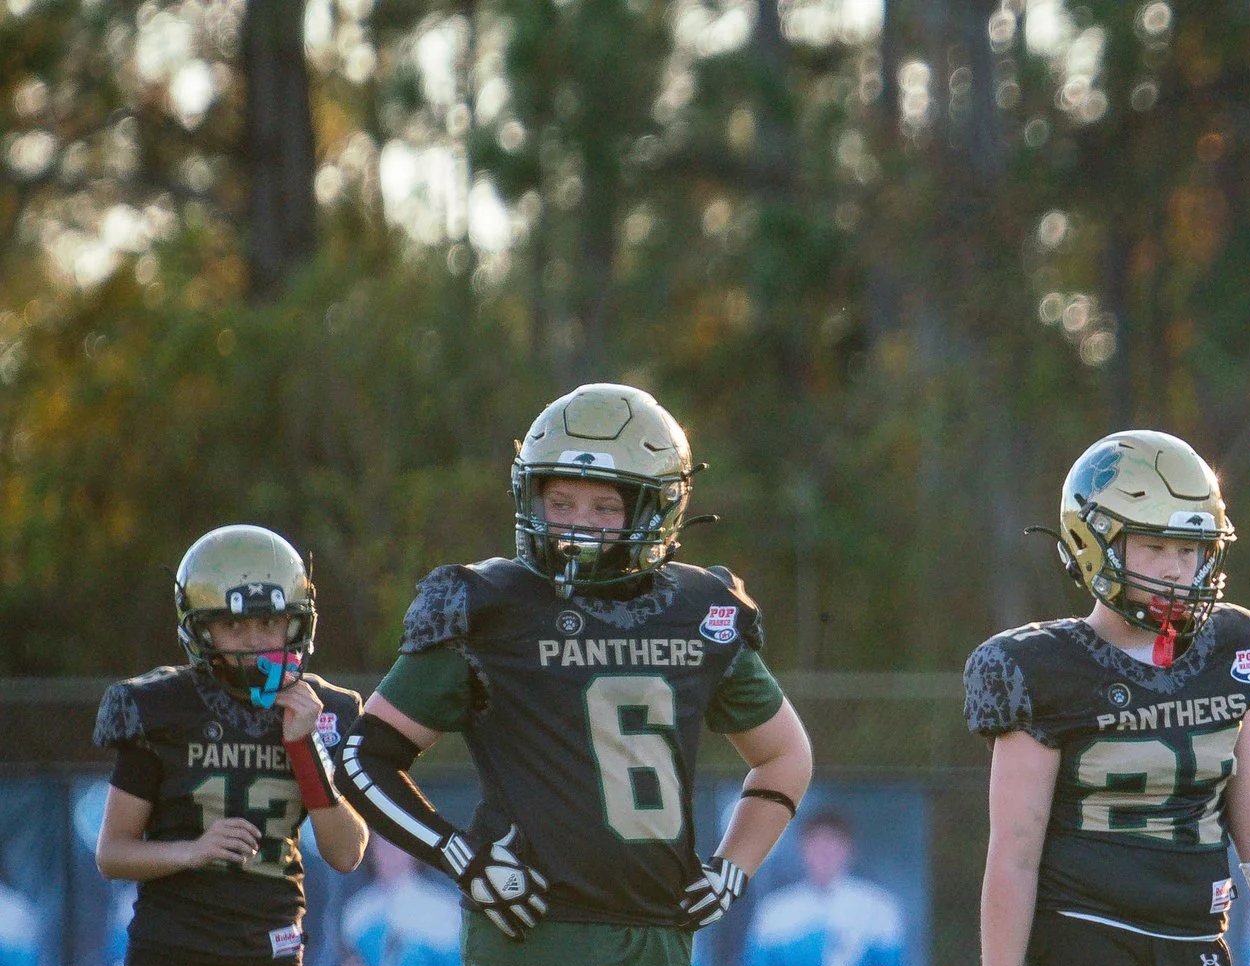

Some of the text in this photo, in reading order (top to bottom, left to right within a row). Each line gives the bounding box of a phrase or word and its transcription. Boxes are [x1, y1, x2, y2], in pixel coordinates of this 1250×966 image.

[710, 608, 734, 618] POP
[539, 639, 704, 667] PANTHERS
[1096, 693, 1247, 732] PANTHERS
[187, 742, 291, 770] PANTHE
[582, 673, 684, 844] 6
[1077, 727, 1239, 848] 27
